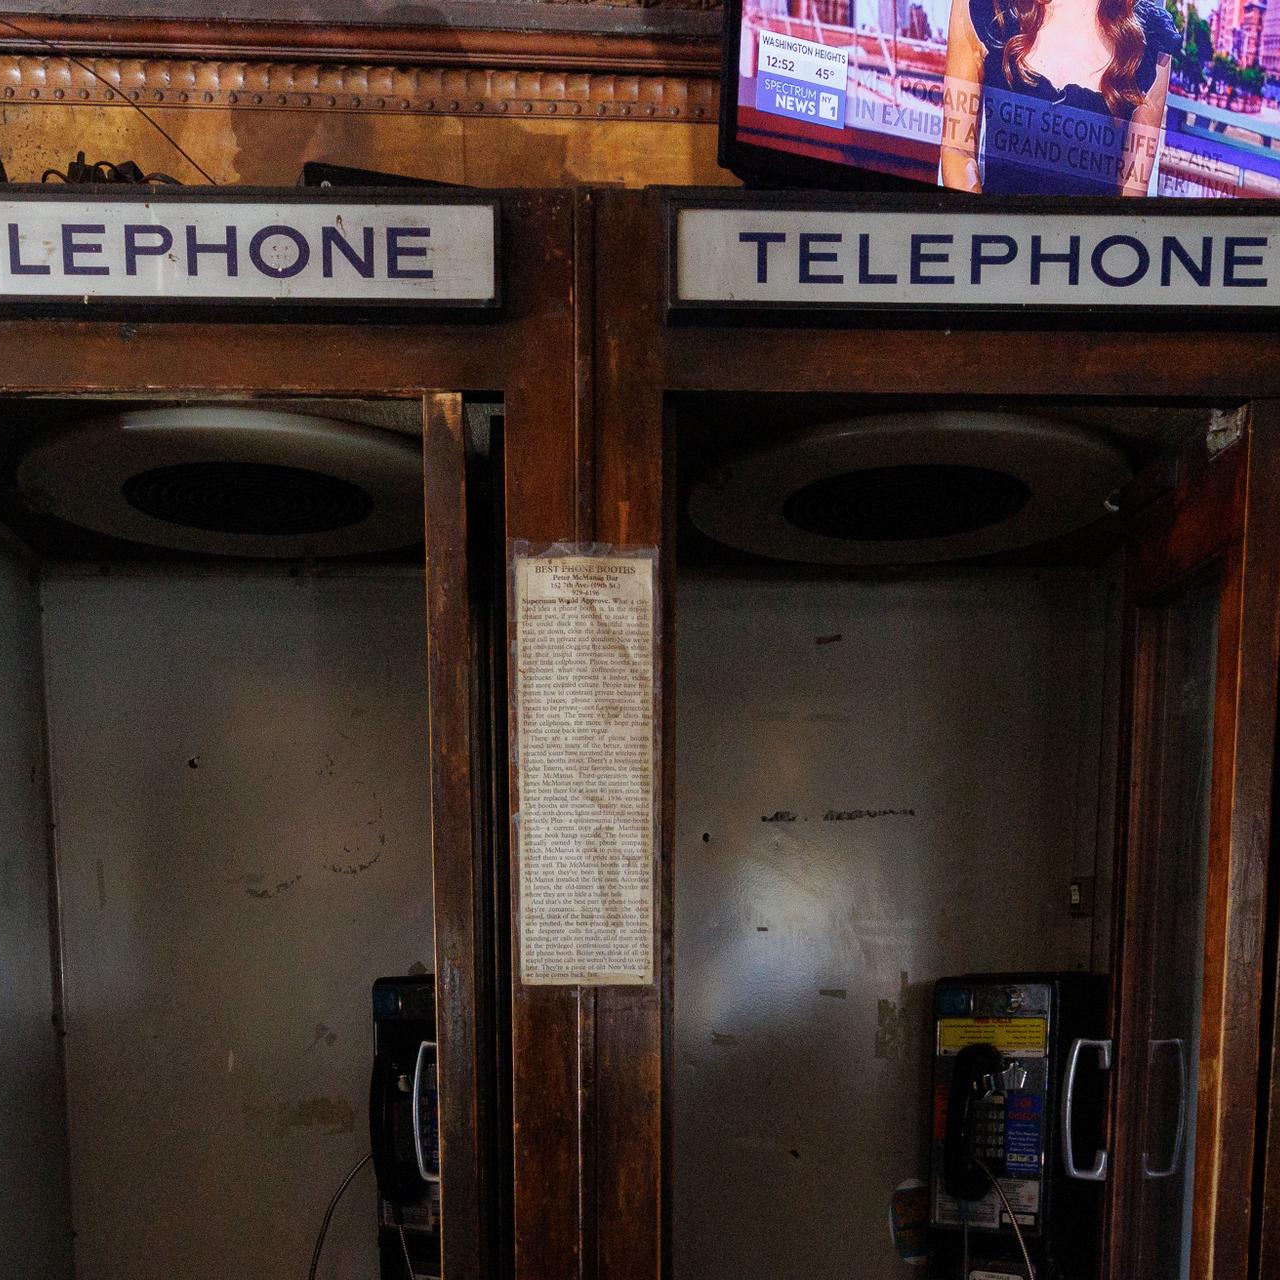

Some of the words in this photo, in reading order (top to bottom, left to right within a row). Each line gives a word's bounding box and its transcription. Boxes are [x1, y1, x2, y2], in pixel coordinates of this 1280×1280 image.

[762, 35, 813, 57] WASHINGTON
[814, 49, 846, 64] HEIGHTS
[766, 55, 795, 72] 12:52
[815, 68, 835, 80] 45°
[764, 79, 817, 100] SPECTRUM
[775, 93, 816, 116] NEWS
[830, 106, 836, 117] 1
[854, 96, 877, 116] IN
[881, 103, 960, 140] EXHIBIT
[994, 128, 1062, 163] GRAND
[1067, 144, 1149, 185] CENTRAL
[999, 102, 1037, 128] GET
[1040, 111, 1114, 150] SECOND
[1123, 132, 1157, 159] LIFE
[739, 232, 1268, 287] TELEPHONE
[535, 565, 558, 574] BEST
[562, 565, 594, 574] PHONE
[597, 565, 636, 575] BOOTHS
